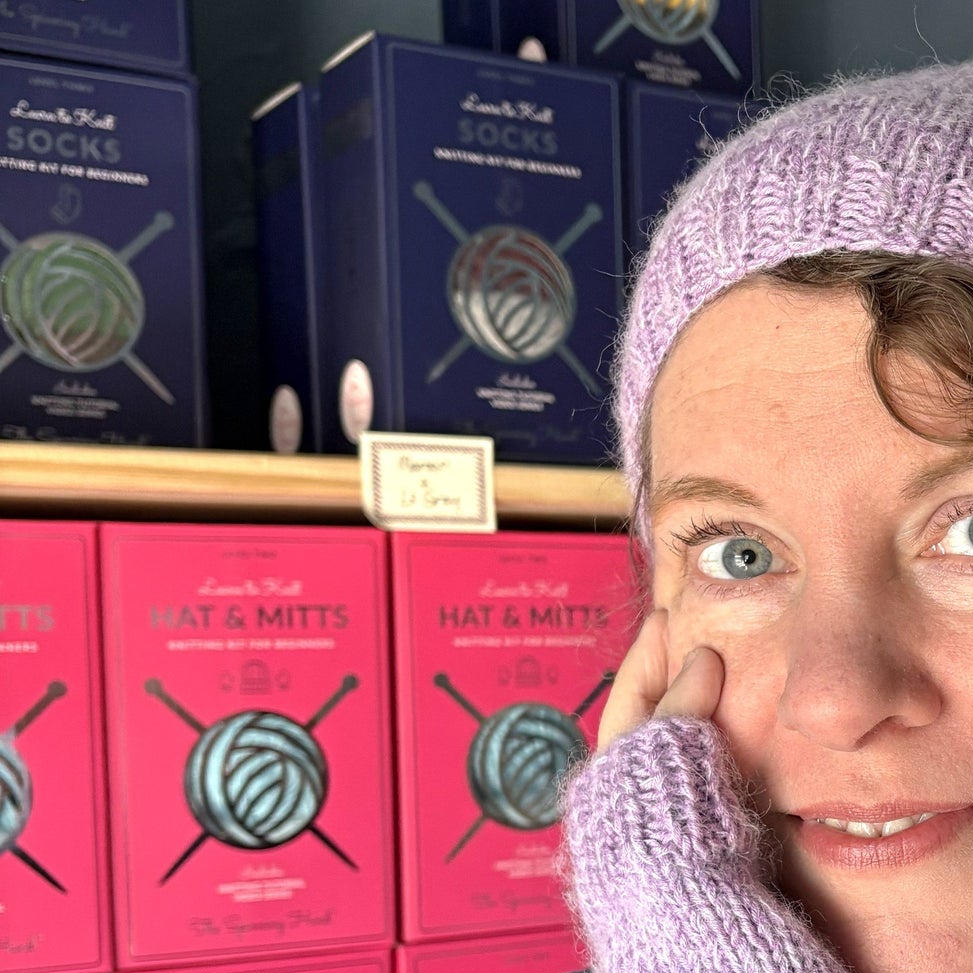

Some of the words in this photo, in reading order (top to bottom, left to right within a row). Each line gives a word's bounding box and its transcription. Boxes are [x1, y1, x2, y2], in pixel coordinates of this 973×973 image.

[6, 125, 122, 164] SOCKS
[456, 117, 559, 155] SOCKS
[150, 604, 214, 630] HAT
[224, 603, 245, 629] &
[257, 603, 350, 630] MITTS
[438, 604, 495, 629] HAT
[502, 604, 520, 629] &
[529, 604, 609, 629] MITTS
